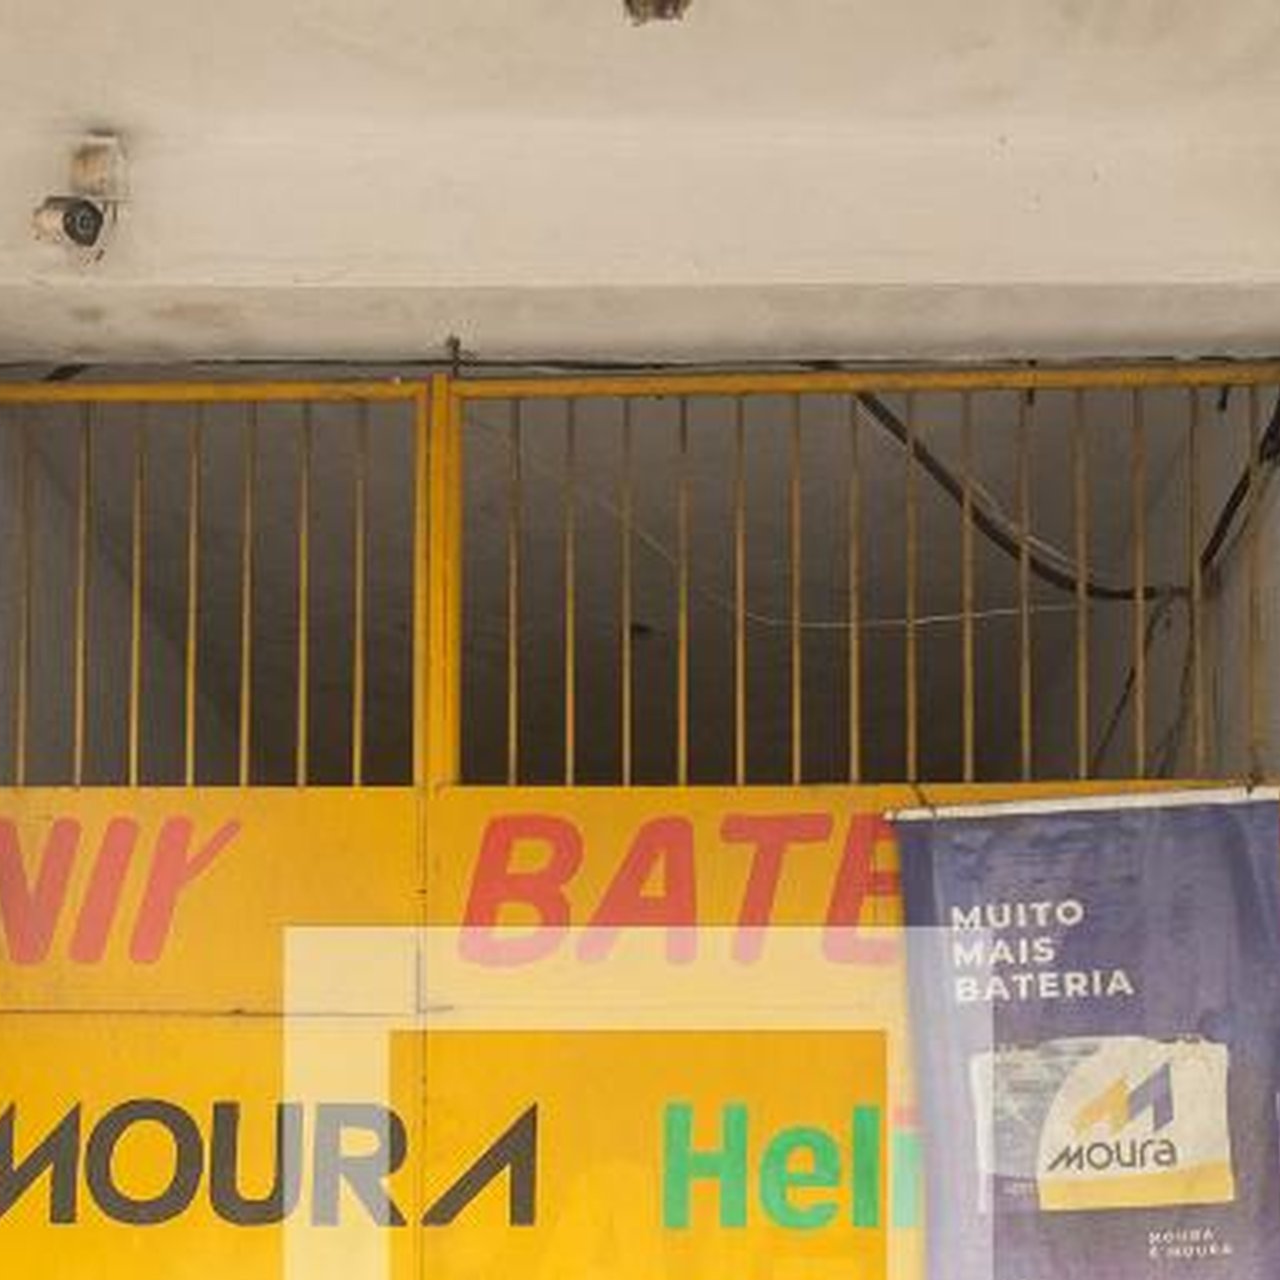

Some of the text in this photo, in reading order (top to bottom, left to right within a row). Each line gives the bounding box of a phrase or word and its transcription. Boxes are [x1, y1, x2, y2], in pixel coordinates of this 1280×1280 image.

[950, 900, 1084, 931] MUITO
[953, 936, 1056, 968] MAIS
[955, 968, 1135, 1002] BATERIA
